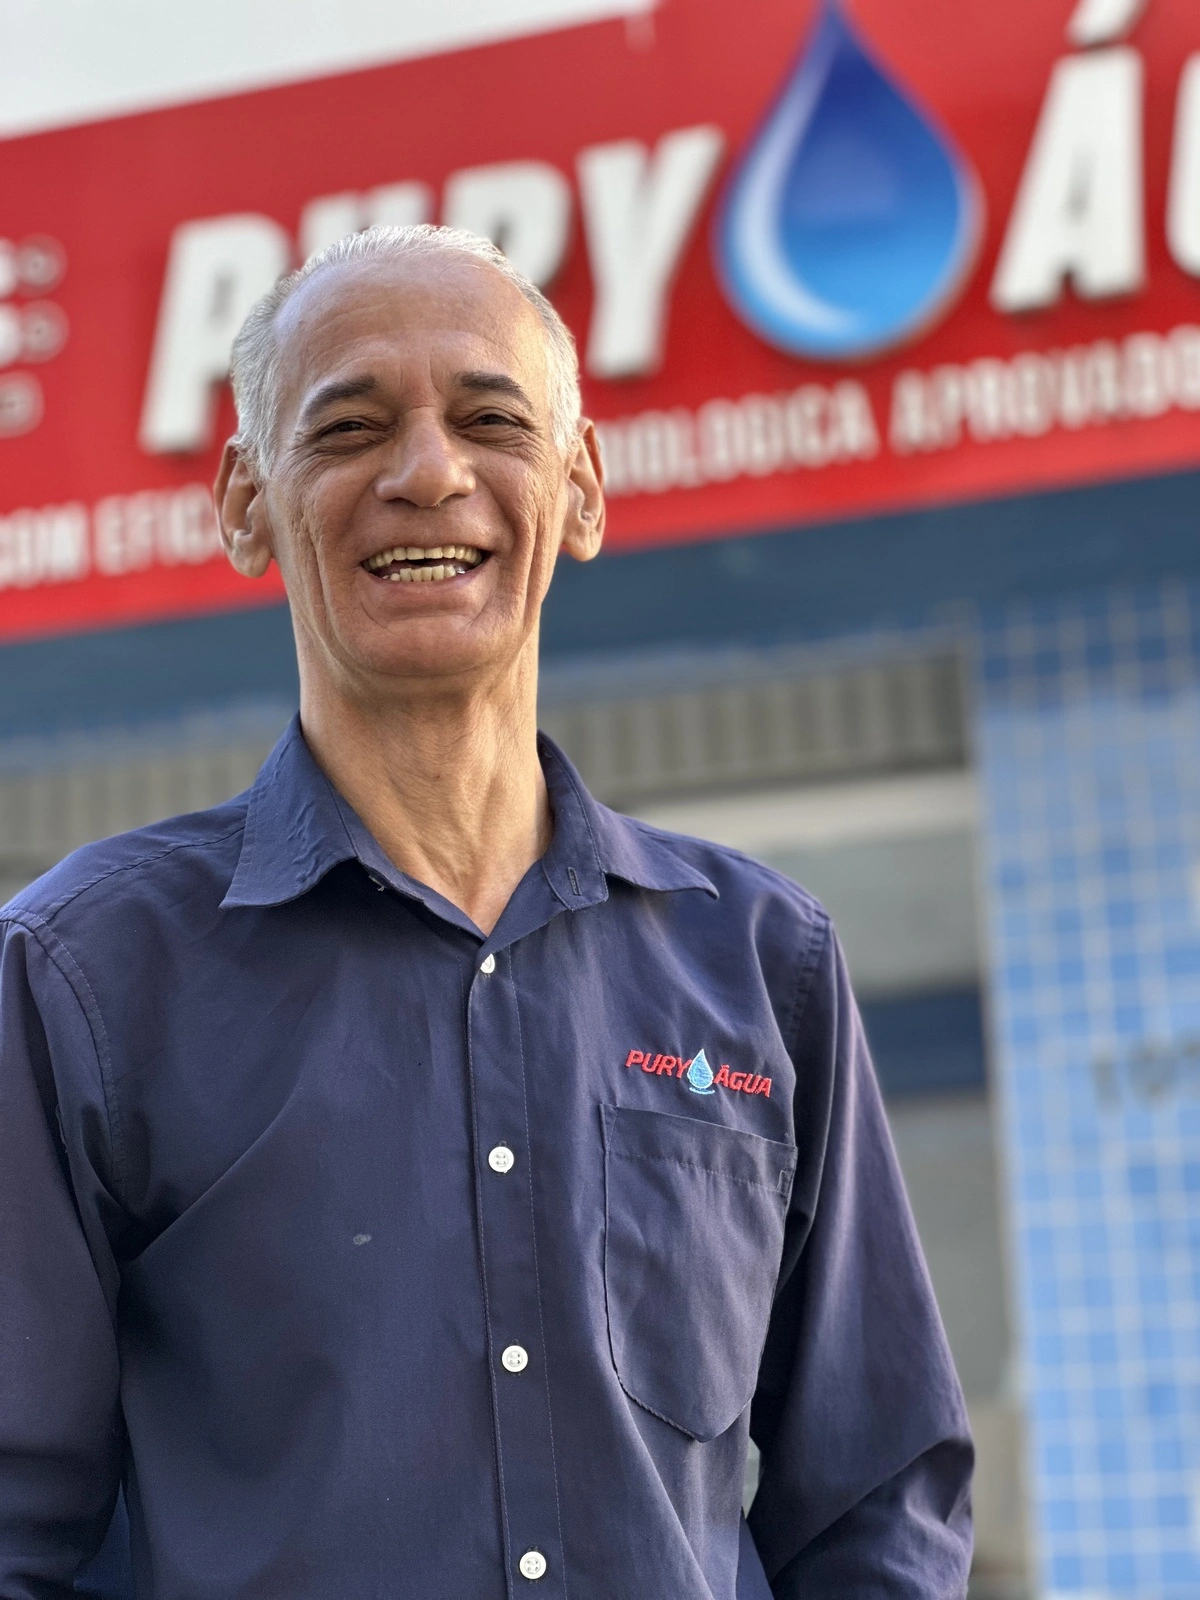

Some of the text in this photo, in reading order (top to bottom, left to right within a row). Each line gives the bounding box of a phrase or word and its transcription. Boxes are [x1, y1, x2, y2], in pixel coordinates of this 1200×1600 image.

[989, 0, 1200, 313] Á
[93, 483, 222, 577] EFIC
[596, 379, 880, 498] IOLOGICA
[625, 1049, 692, 1079] PURY
